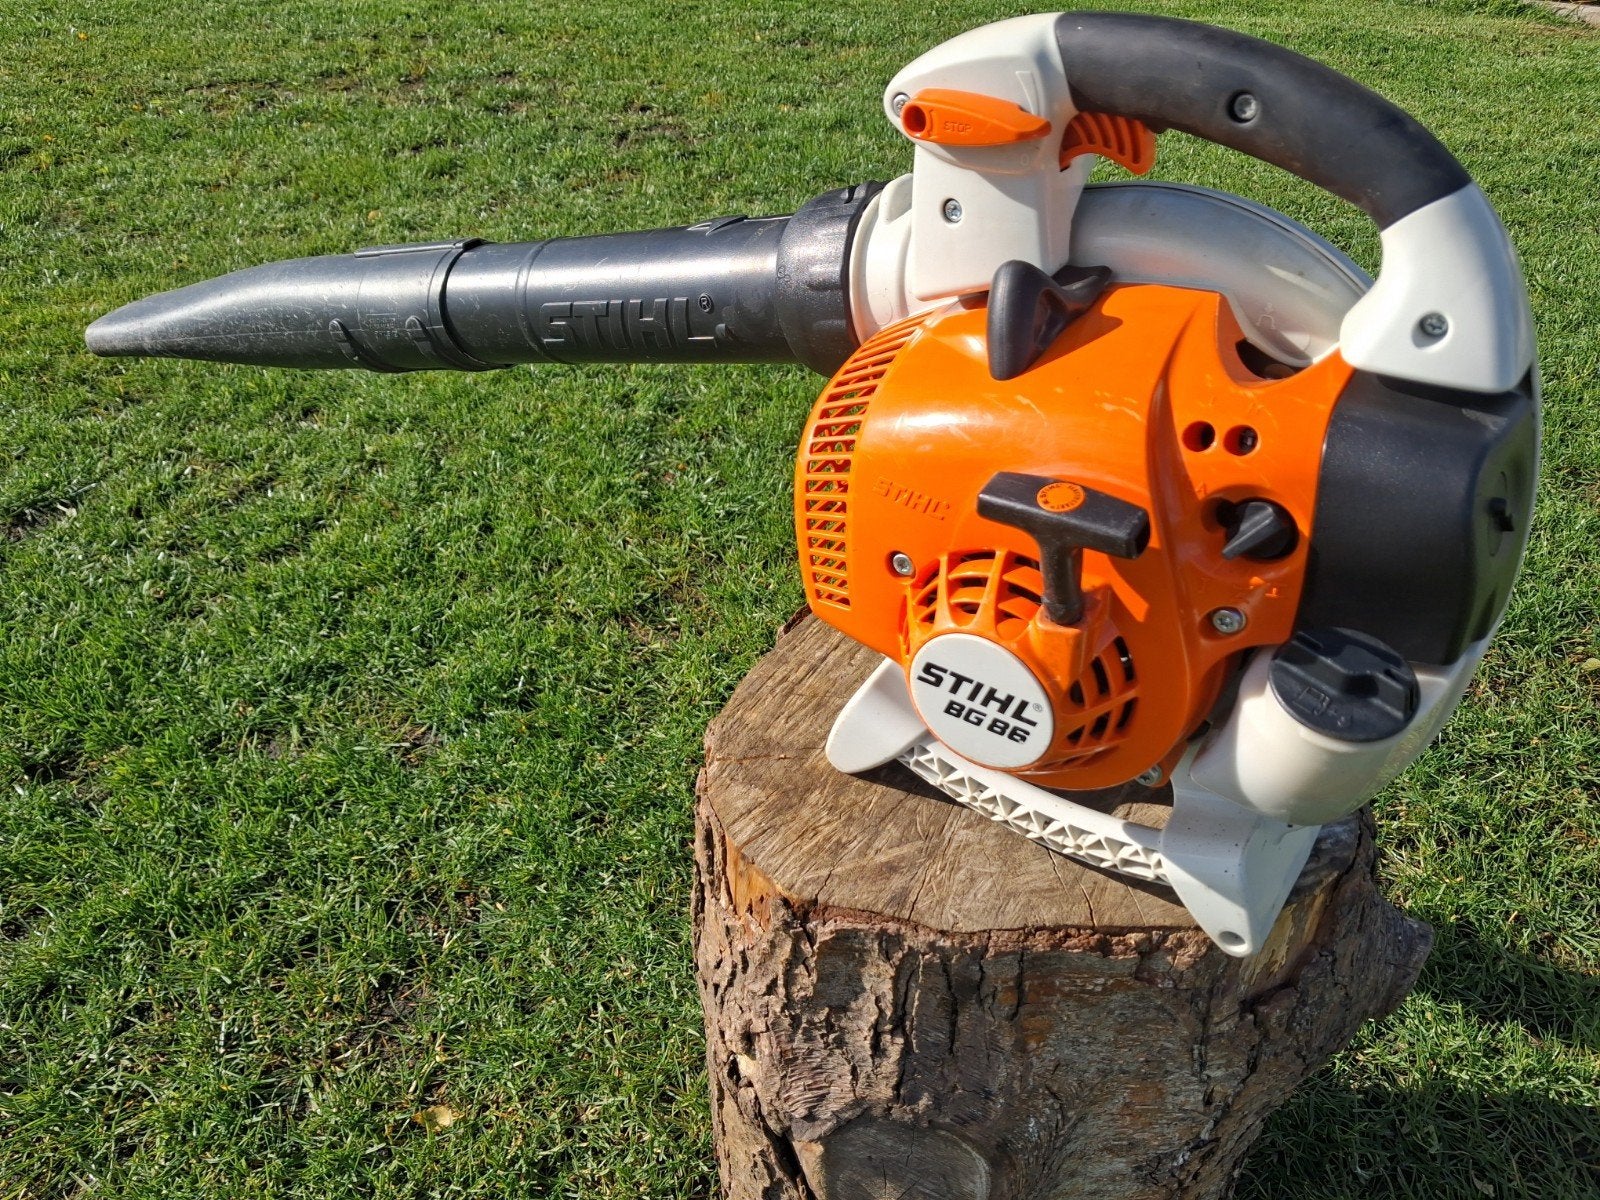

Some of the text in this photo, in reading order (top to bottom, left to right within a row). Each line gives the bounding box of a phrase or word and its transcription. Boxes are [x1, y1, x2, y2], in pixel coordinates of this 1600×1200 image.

[944, 120, 972, 133] STOP
[917, 662, 1037, 727] STIHL
[943, 700, 1030, 744] BG 86
